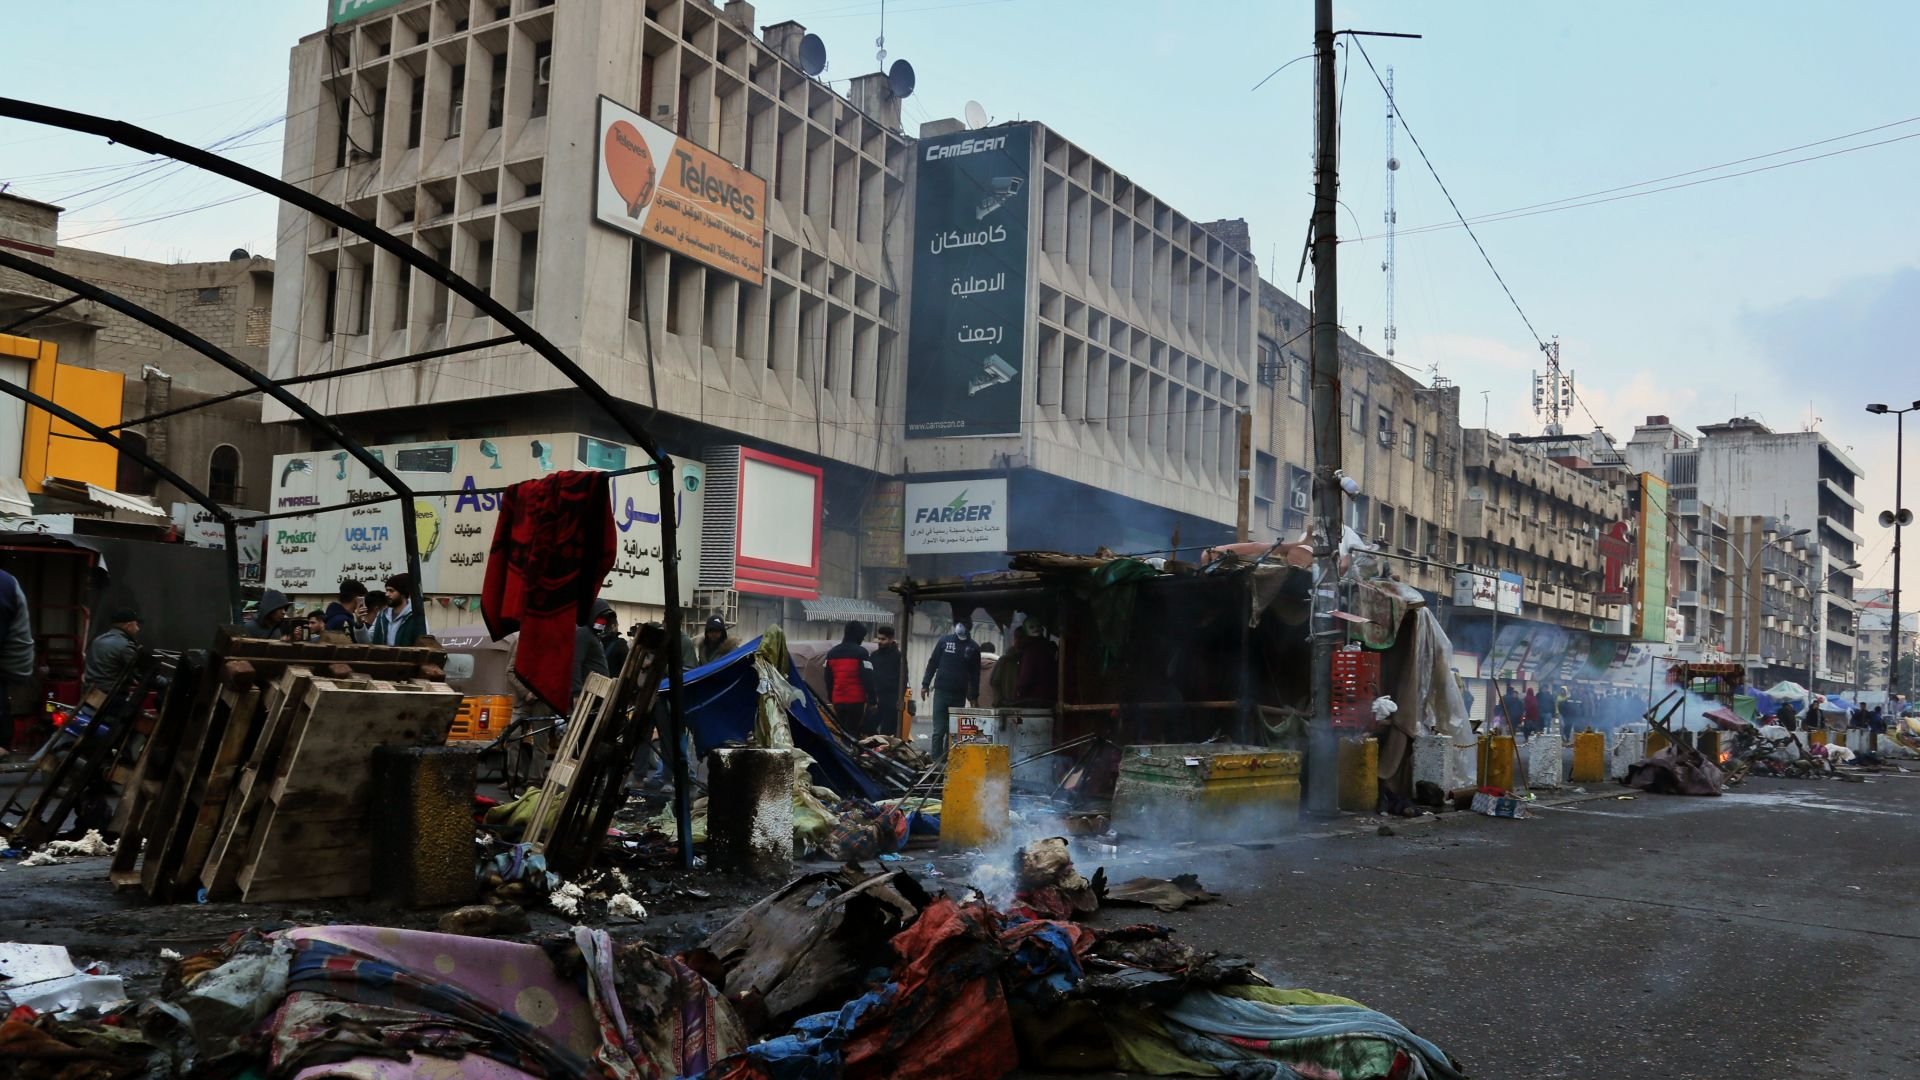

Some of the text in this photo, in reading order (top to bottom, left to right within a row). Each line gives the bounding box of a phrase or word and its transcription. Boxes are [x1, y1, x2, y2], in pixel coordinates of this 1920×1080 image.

[614, 126, 648, 159] Televes
[675, 148, 755, 221] Televes
[929, 224, 1007, 255] كامسكان
[717, 244, 740, 264] Televes
[950, 272, 1005, 300] الاصلية
[957, 323, 1004, 345] رجعت
[909, 420, 965, 431] www.camscan.ca
[915, 505, 992, 524] FARBER
[345, 527, 389, 542] VOLTA
[454, 523, 482, 537] صوتيات
[449, 551, 484, 567] الكترونيات
[623, 539, 649, 559] مراقبة
